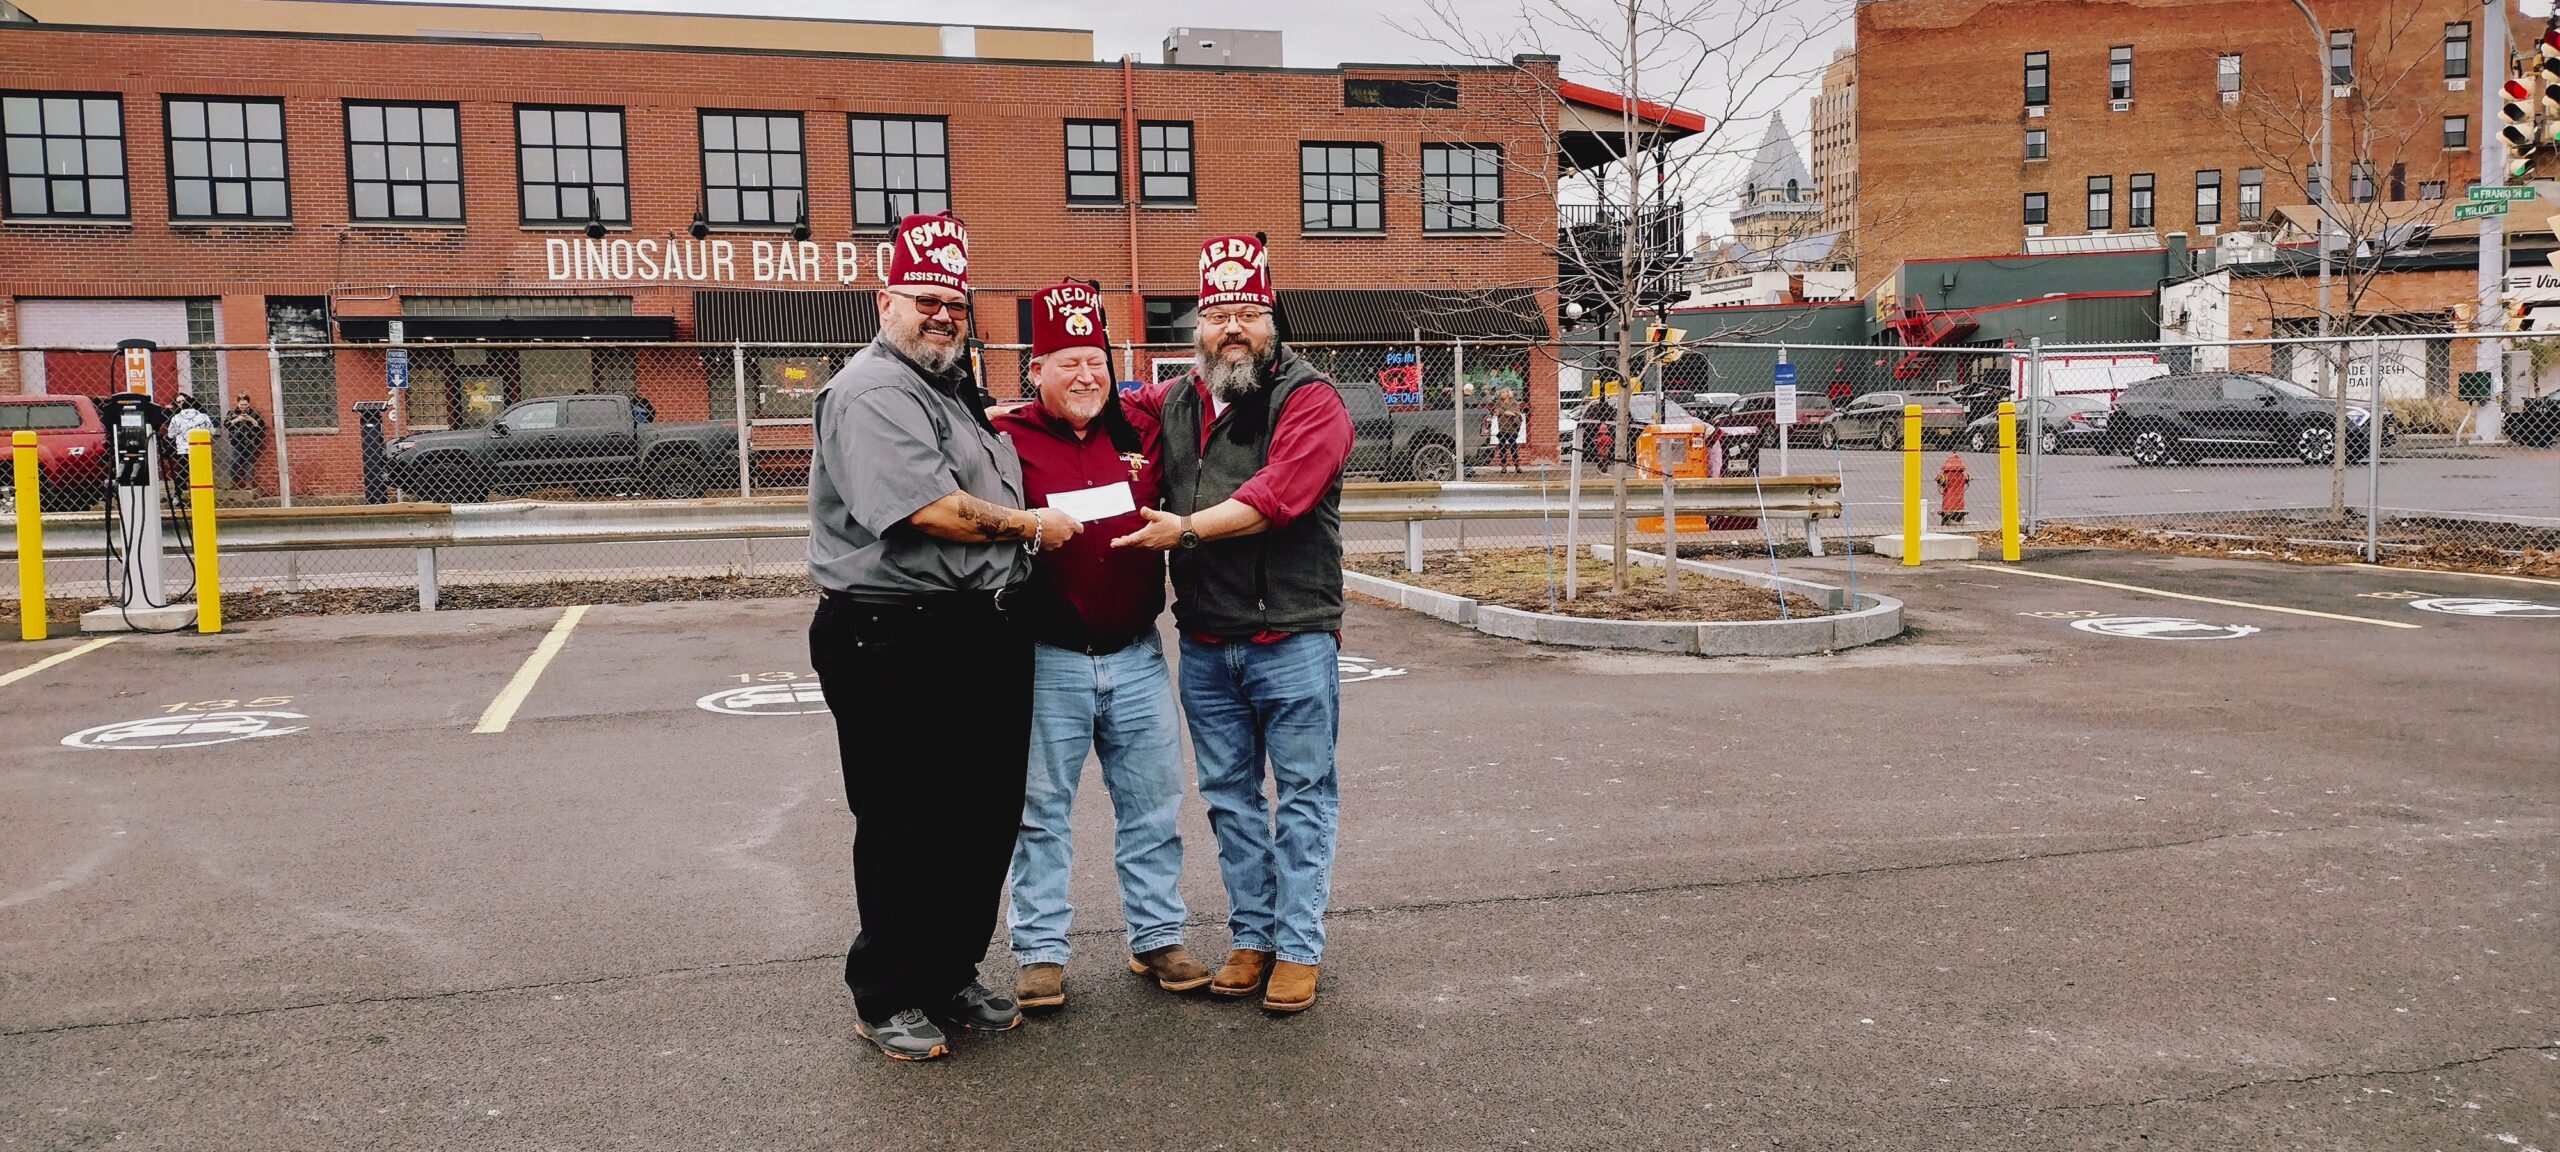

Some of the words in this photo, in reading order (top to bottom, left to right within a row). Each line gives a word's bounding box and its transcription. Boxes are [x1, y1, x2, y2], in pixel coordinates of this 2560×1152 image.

[546, 238, 735, 282] DINOSAUR
[752, 241, 820, 282] BAR
[1199, 238, 1266, 293] MEDIA
[903, 272, 960, 286] ASSISTANT
[2536, 274, 2560, 289] Vin
[1043, 287, 1101, 322] MEDIA
[1204, 292, 1259, 305] POTENTATE
[1386, 353, 1402, 364] PIG
[1404, 352, 1415, 363] IN
[130, 369, 145, 378] EV
[2371, 365, 2405, 376] RESH
[1383, 393, 1398, 403] PIG
[159, 695, 295, 713] 135
